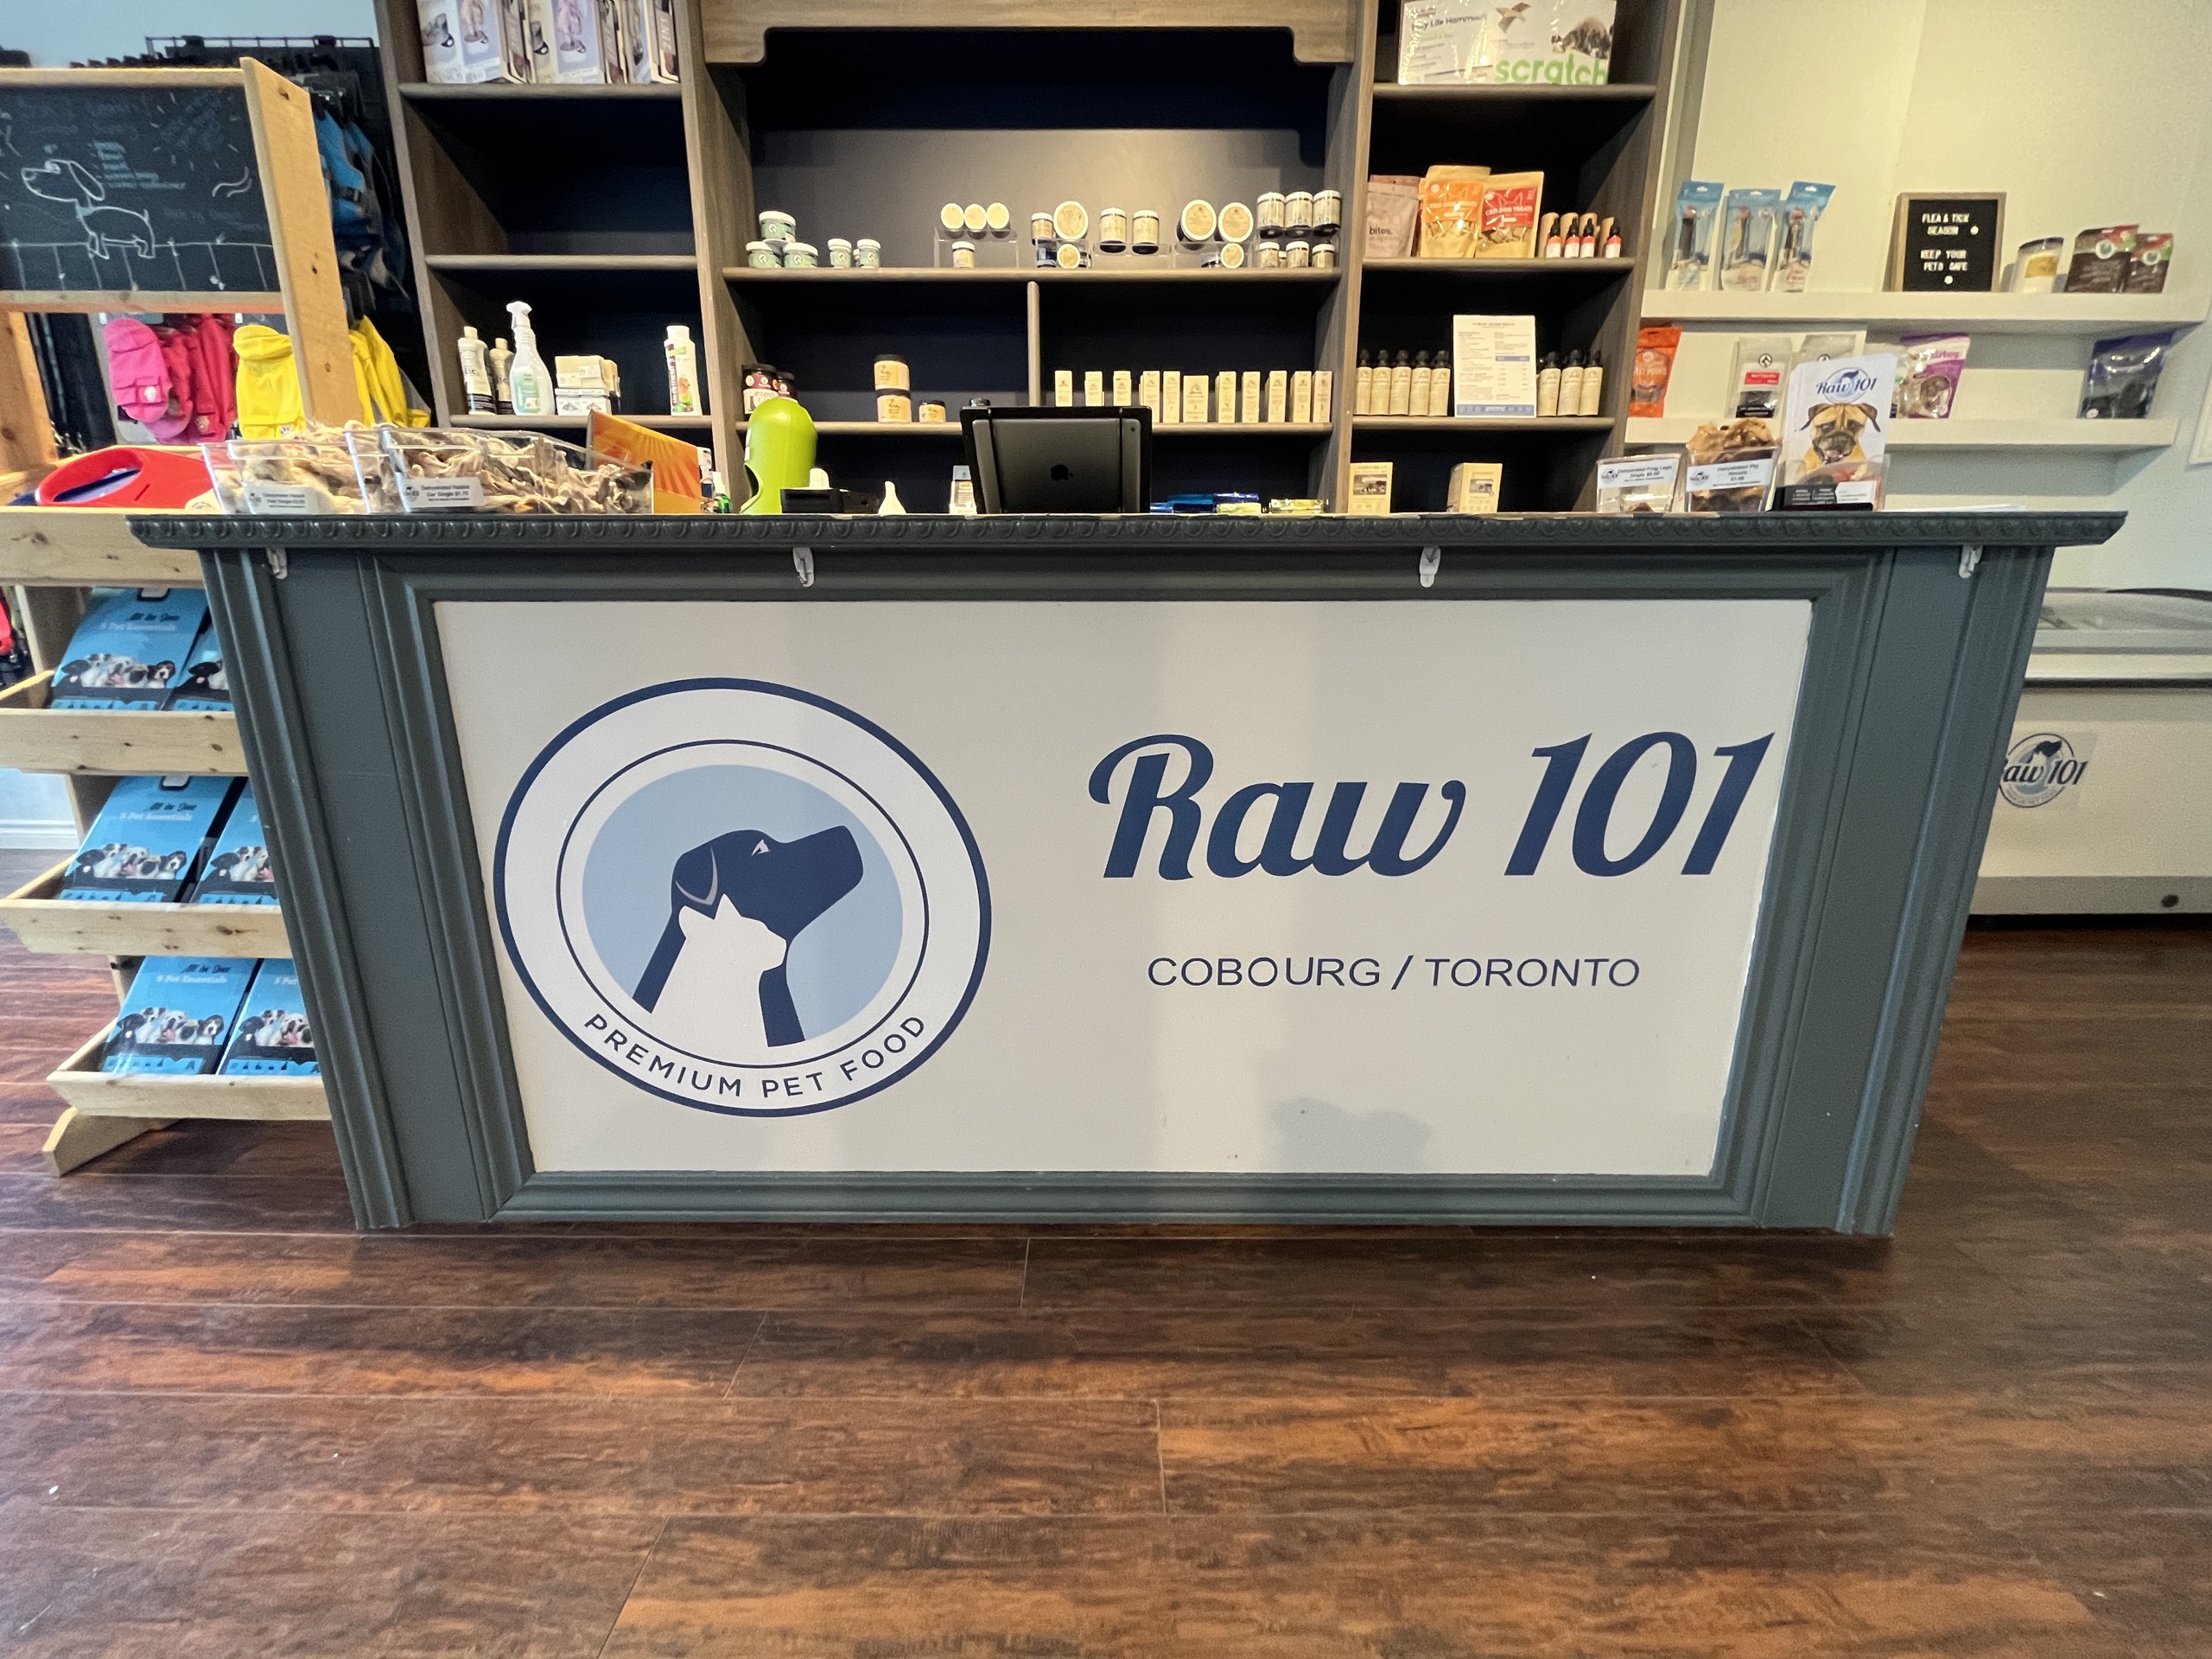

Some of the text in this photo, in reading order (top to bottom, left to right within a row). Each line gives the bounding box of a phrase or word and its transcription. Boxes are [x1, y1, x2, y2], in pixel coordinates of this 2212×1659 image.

[1495, 53, 1608, 85] scratch
[1922, 213, 1942, 224] FLEA
[1952, 213, 1970, 223] TICK
[1920, 249, 1942, 259] KEEP
[1815, 378, 1878, 394] Raw 101
[2004, 759, 2088, 785] aw 101
[1088, 730, 1776, 881] Raw 101
[1147, 957, 1381, 988] COBOURG
[1424, 957, 1640, 988] TORONTO
[584, 1014, 925, 1098] PREMIUM PET FOOD
